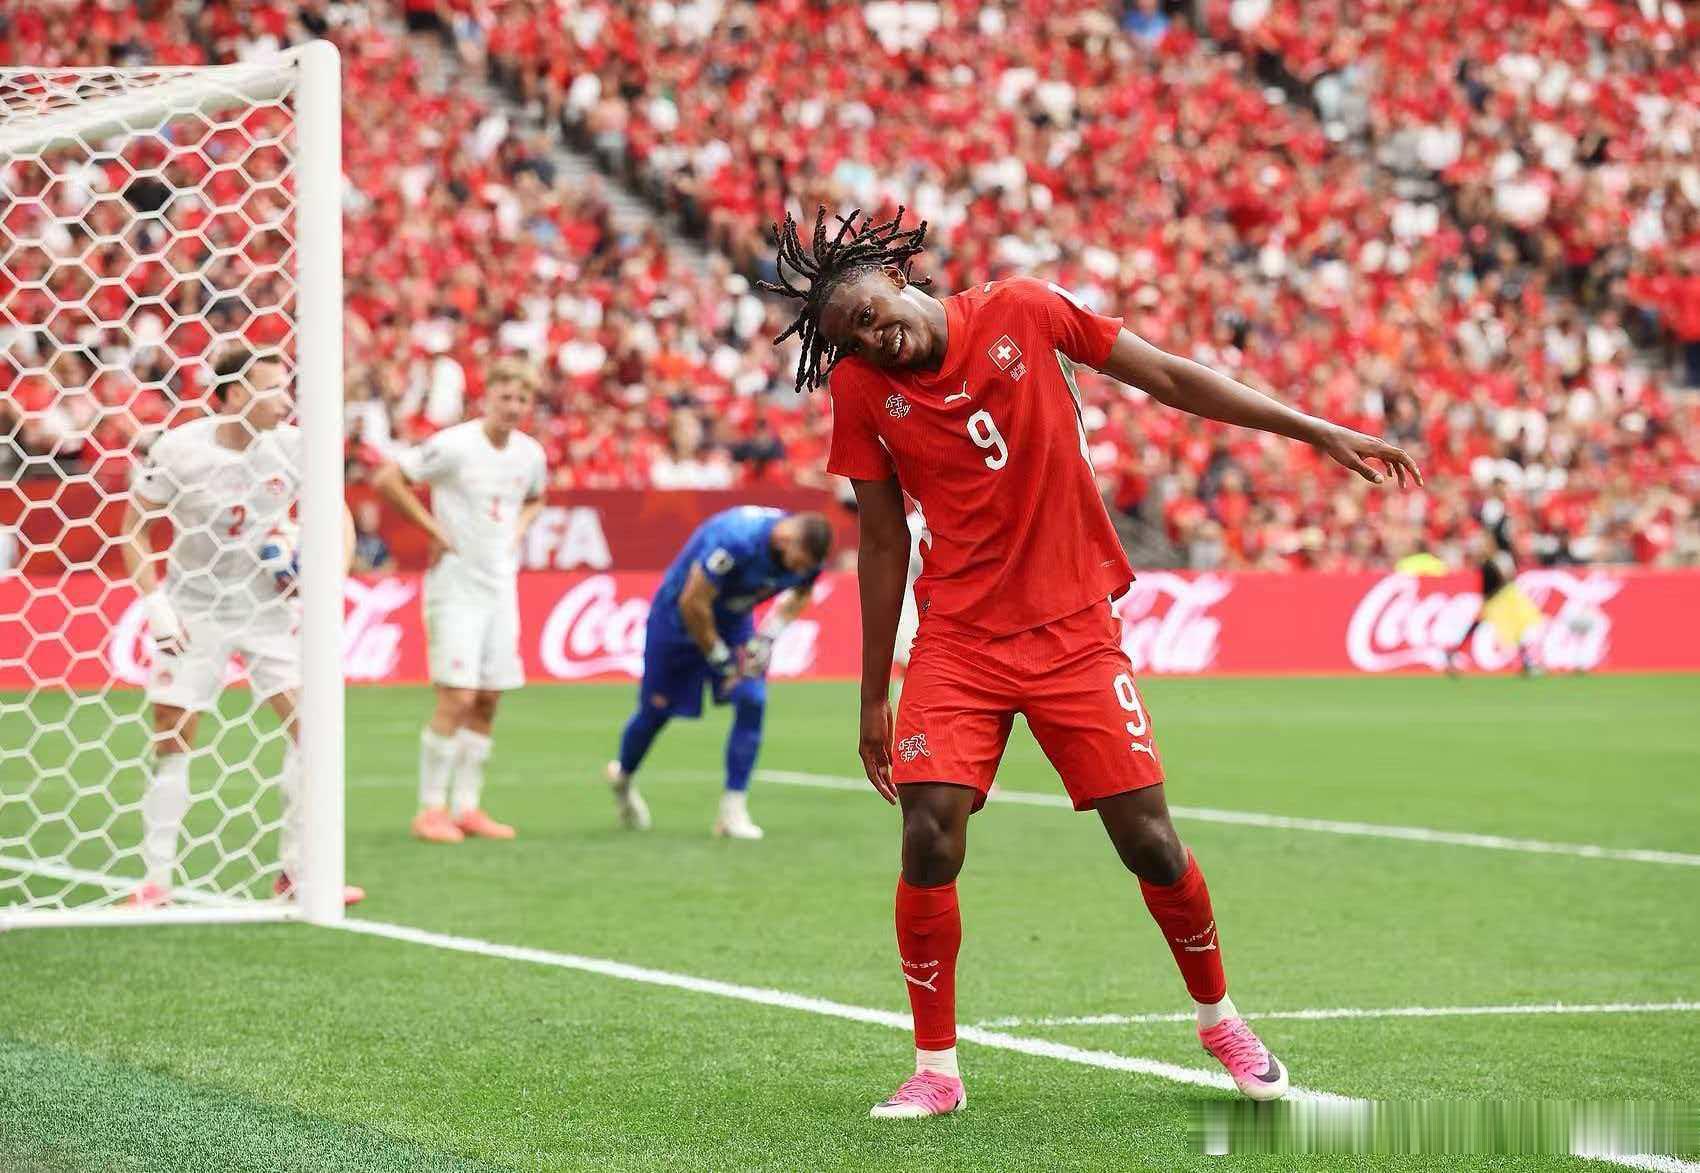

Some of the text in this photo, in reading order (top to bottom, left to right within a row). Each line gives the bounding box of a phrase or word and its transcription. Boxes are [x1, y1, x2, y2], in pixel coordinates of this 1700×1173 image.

[966, 409, 1009, 470] 9
[227, 505, 247, 538] 2
[527, 506, 614, 570] FA
[1113, 673, 1147, 737] 9
